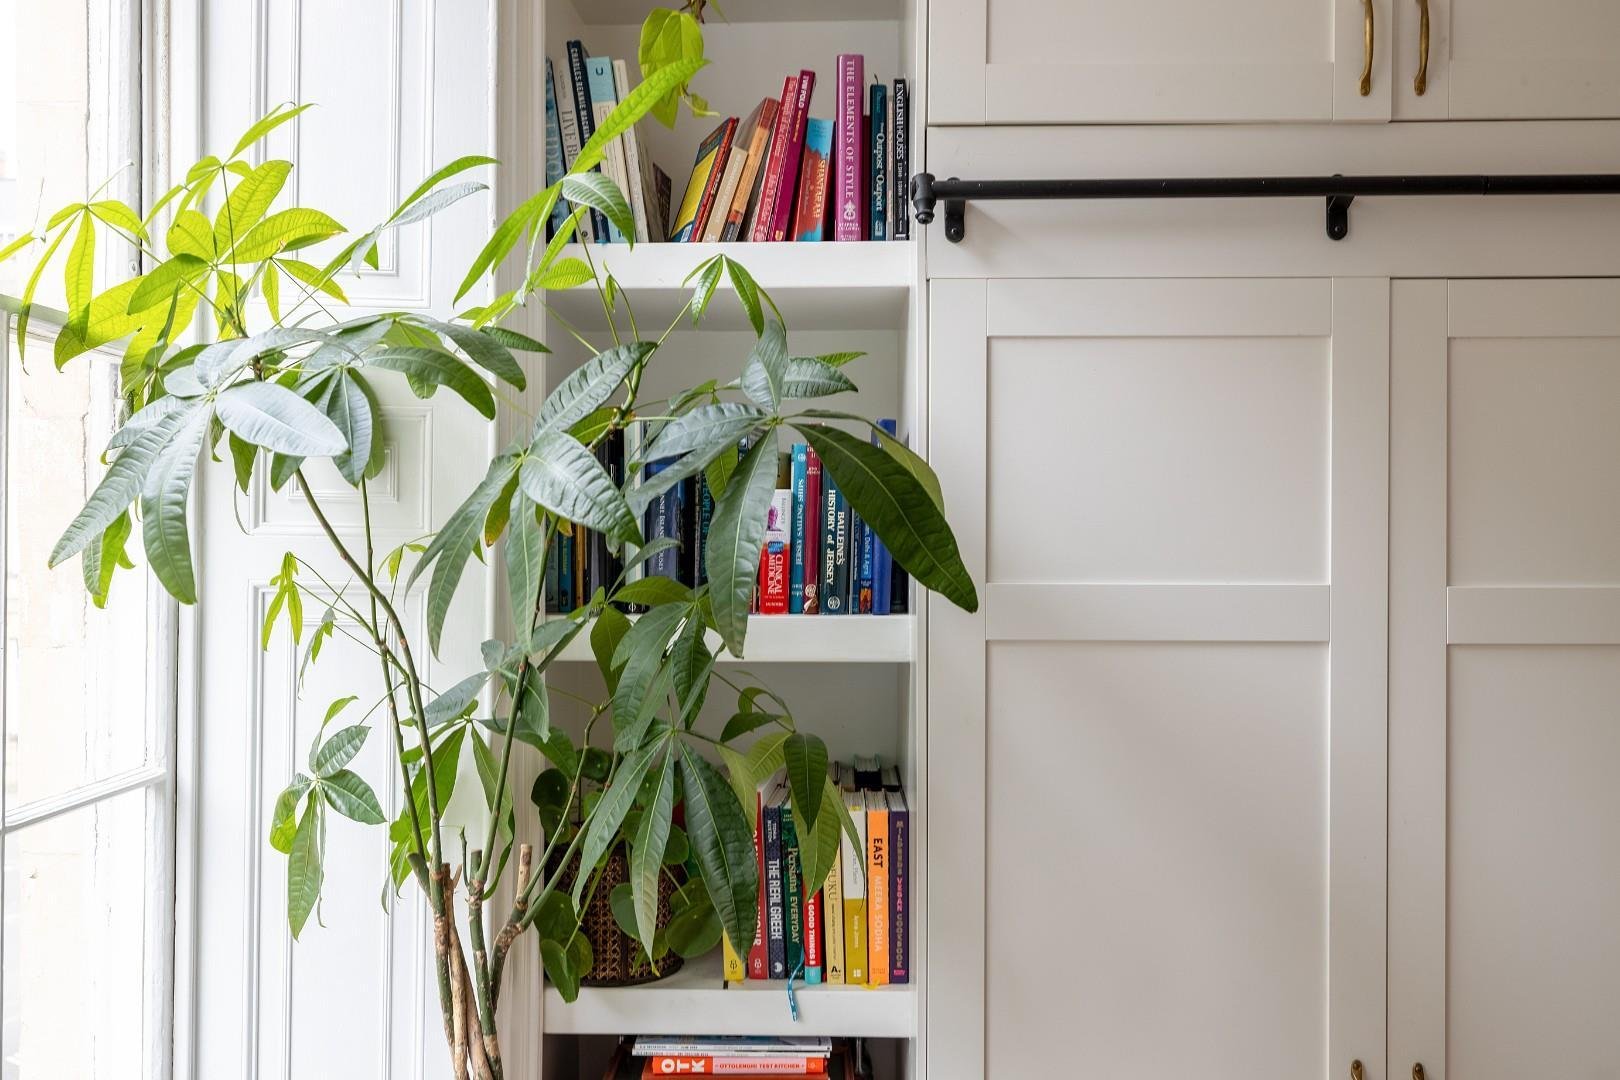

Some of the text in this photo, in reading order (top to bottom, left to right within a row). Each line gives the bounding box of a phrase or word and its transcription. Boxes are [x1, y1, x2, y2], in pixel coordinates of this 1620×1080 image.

[896, 83, 904, 125] ENGLISH
[562, 110, 577, 140] LIVE
[580, 109, 591, 142] MACKIN
[845, 59, 855, 198] THE ELEMENTS OF STYLE
[896, 126, 904, 159] HOUSES
[874, 132, 885, 169] Outpost
[874, 174, 884, 211] Outport
[825, 488, 836, 585] HISTORY of JERSEY
[834, 511, 845, 565] BALLEINE'S
[767, 554, 776, 594] MEDICINE
[774, 554, 783, 594] CLINICAL
[767, 858, 782, 940] THE REAL GREEK
[787, 846, 801, 944] Persiana EVERYDAY
[873, 837, 883, 952] EAST MEERA SODHA
[807, 904, 815, 959] GOOD THINGS
[661, 1058, 705, 1073] OTK
